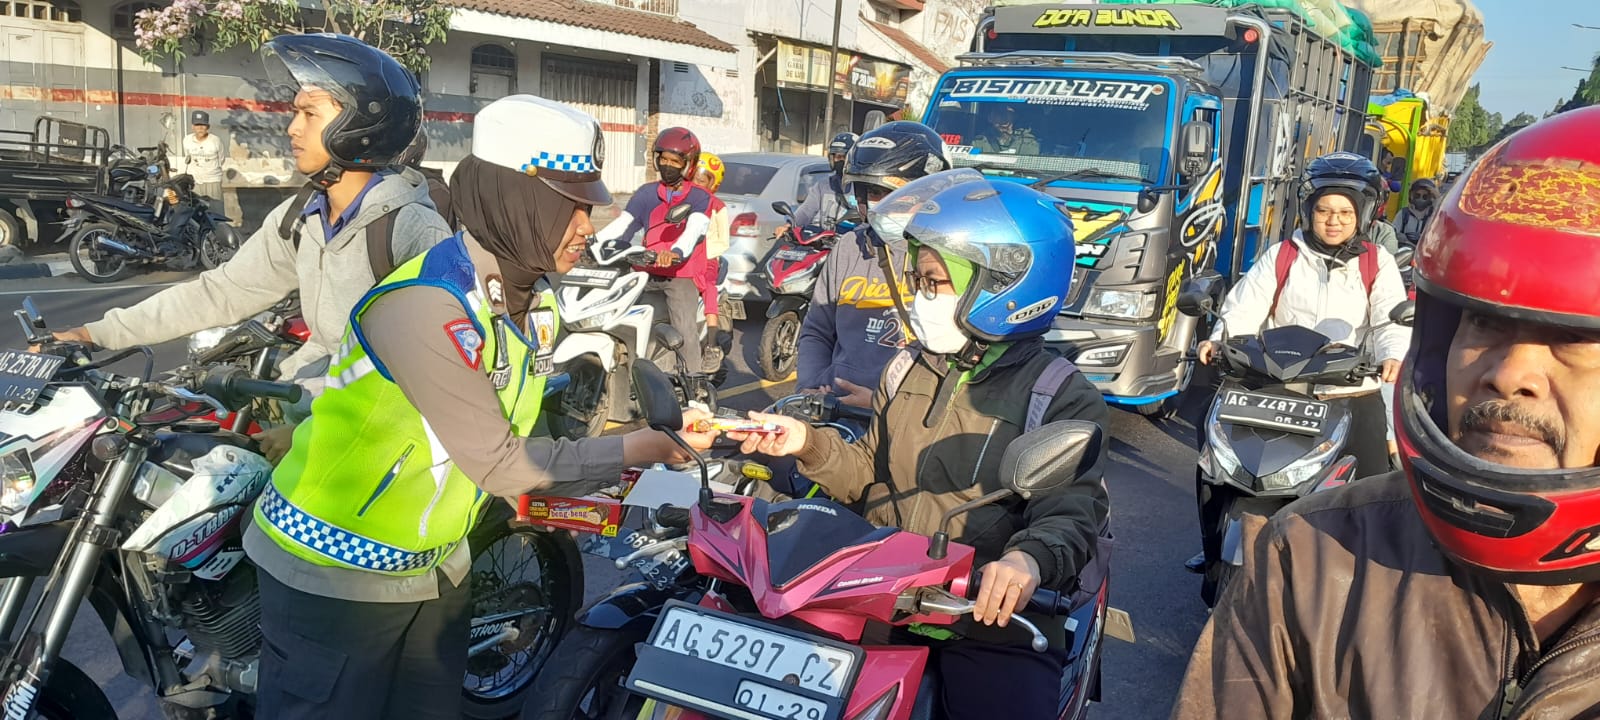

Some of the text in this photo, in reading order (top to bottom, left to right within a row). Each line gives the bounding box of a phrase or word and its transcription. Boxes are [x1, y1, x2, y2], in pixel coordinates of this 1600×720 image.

[1033, 9, 1182, 30] DO'A BUNDA
[951, 78, 1151, 103] BISMILLAH
[7, 354, 43, 377] 2578
[34, 358, 62, 380] NX
[1228, 393, 1325, 418] AG 4487 CJ
[550, 509, 588, 519] beng-beng
[797, 503, 838, 517] HONDA
[664, 550, 689, 575] CH
[660, 618, 844, 692] AG 5297 CZ
